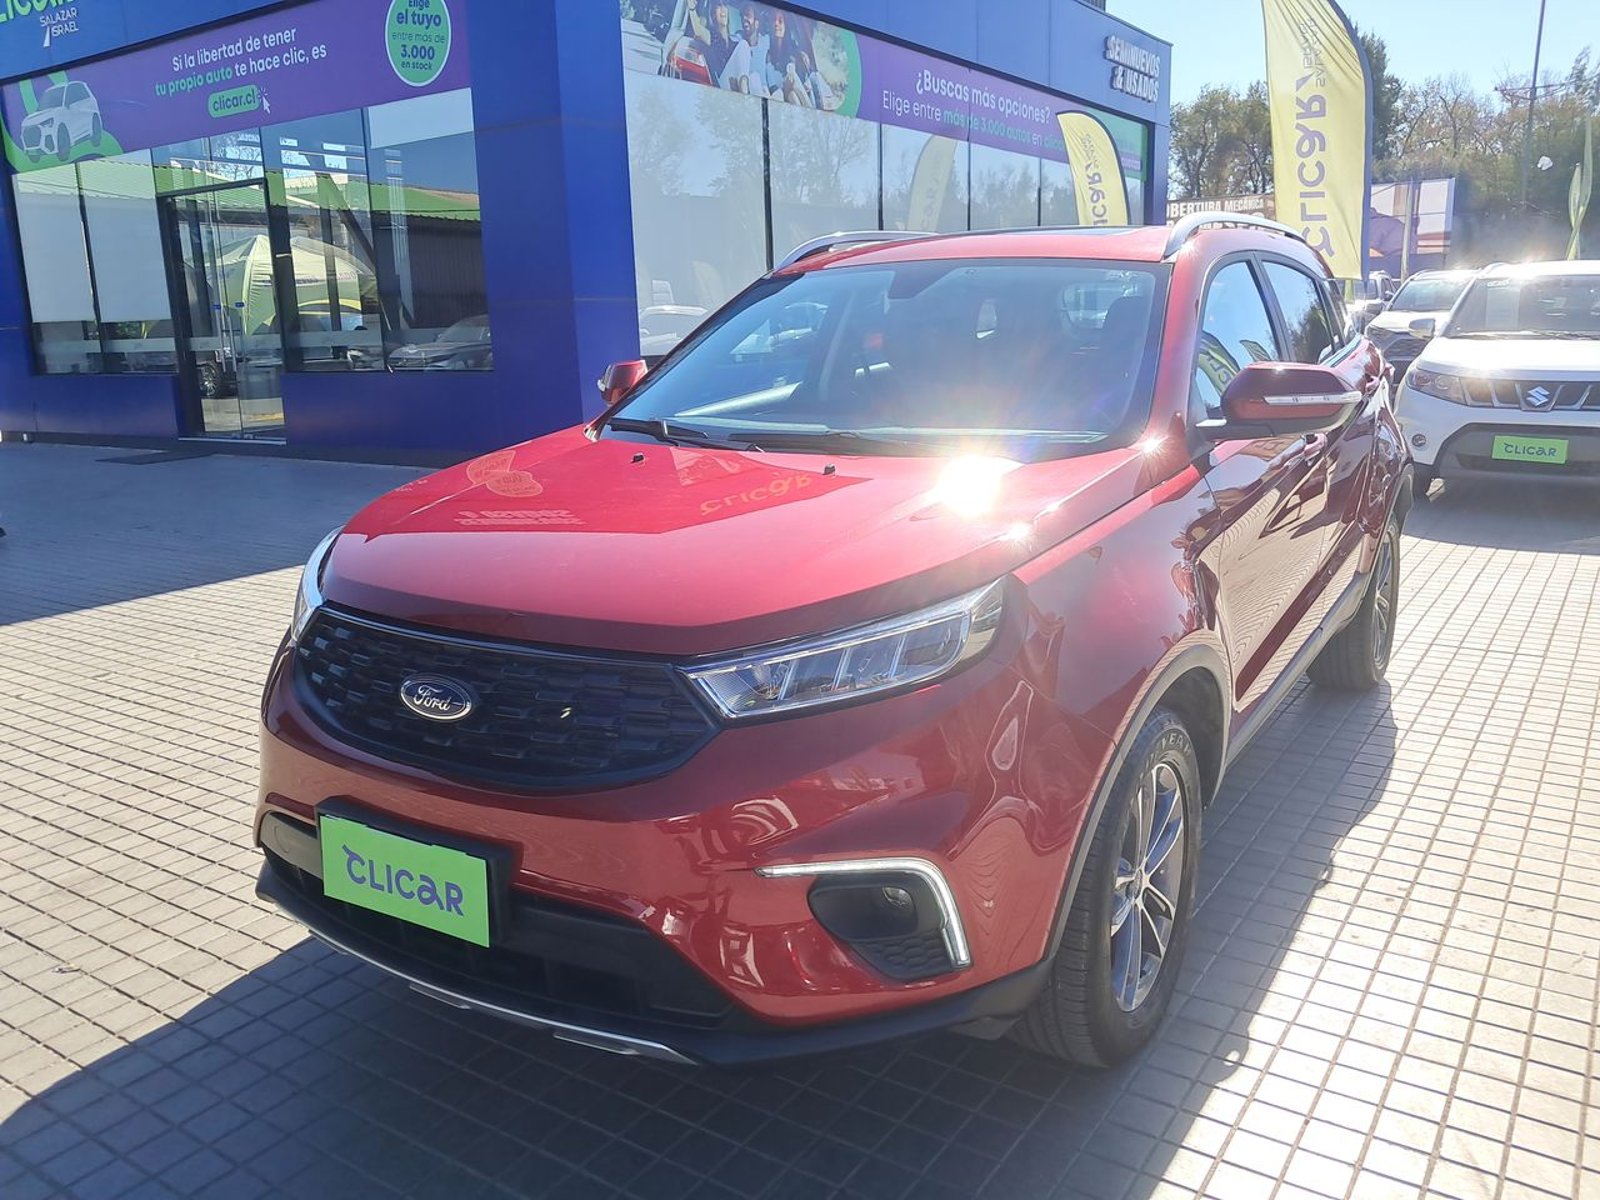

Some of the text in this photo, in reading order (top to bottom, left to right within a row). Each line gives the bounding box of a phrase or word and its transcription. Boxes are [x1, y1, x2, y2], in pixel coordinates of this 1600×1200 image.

[40, 7, 77, 27] SALAZAR
[51, 21, 79, 37] ISRAEL
[396, 9, 441, 30] el tuyo
[172, 28, 297, 71] Si la libertad de tener
[401, 44, 435, 60] 3.000
[1106, 35, 1160, 78] SEMINUEVOS
[155, 44, 327, 97] tu propio auto te hace clic, es
[412, 62, 432, 70] stock
[915, 69, 1051, 124] ¿Buscas más opciones?
[1124, 68, 1159, 102] USADOS
[213, 88, 256, 112] clicar.cl
[883, 90, 911, 116] Elige
[913, 102, 942, 122] entre
[1166, 201, 1221, 218] BERTURA
[413, 684, 451, 711] Ford
